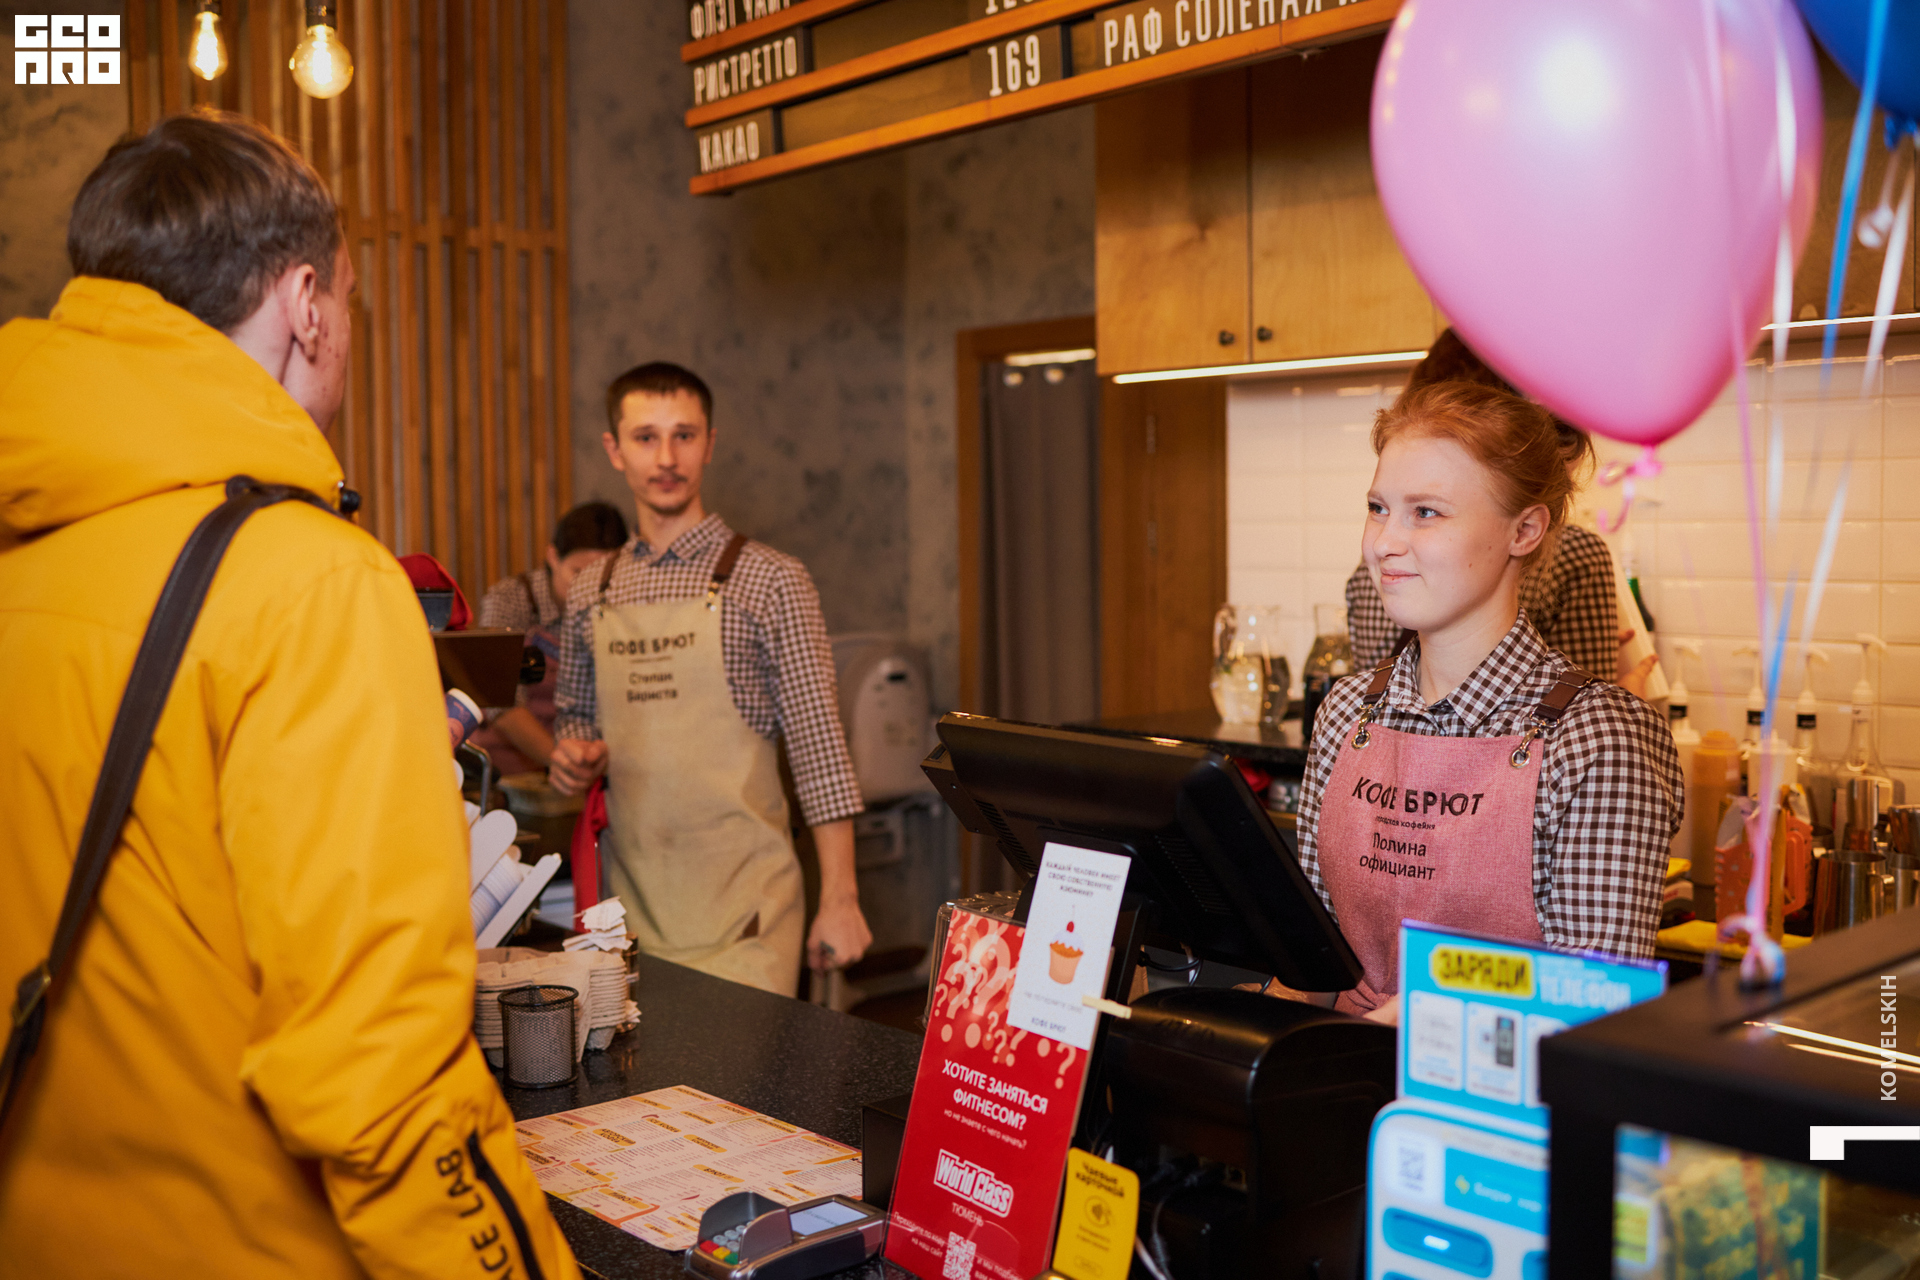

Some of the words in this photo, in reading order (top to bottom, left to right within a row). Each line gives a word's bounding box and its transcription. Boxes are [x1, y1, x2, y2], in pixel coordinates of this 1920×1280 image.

[1104, 7, 1163, 67] РАФ
[693, 36, 797, 106] РИСТРЕТТО
[987, 35, 1041, 97] 169
[699, 121, 760, 174] КАКАО
[608, 639, 647, 655] КОФЕ
[652, 632, 695, 653] БРЮТ
[629, 672, 673, 685] Степан
[1400, 821, 1435, 830] кофейня
[1404, 789, 1484, 816] БРЮТ
[1360, 853, 1436, 880] официант
[1373, 832, 1427, 857] Полина
[942, 1059, 987, 1090] ХОТИТЕ
[986, 1077, 1049, 1115] ЗАНЯТЬСЯ
[953, 1088, 1027, 1131] ФИТНЕСОМ?
[435, 1149, 484, 1218] LAB
[937, 1155, 977, 1196] World
[972, 1173, 1010, 1212] Class
[952, 1202, 984, 1227] ТЮМЕНЬ
[469, 1222, 513, 1280] CE
